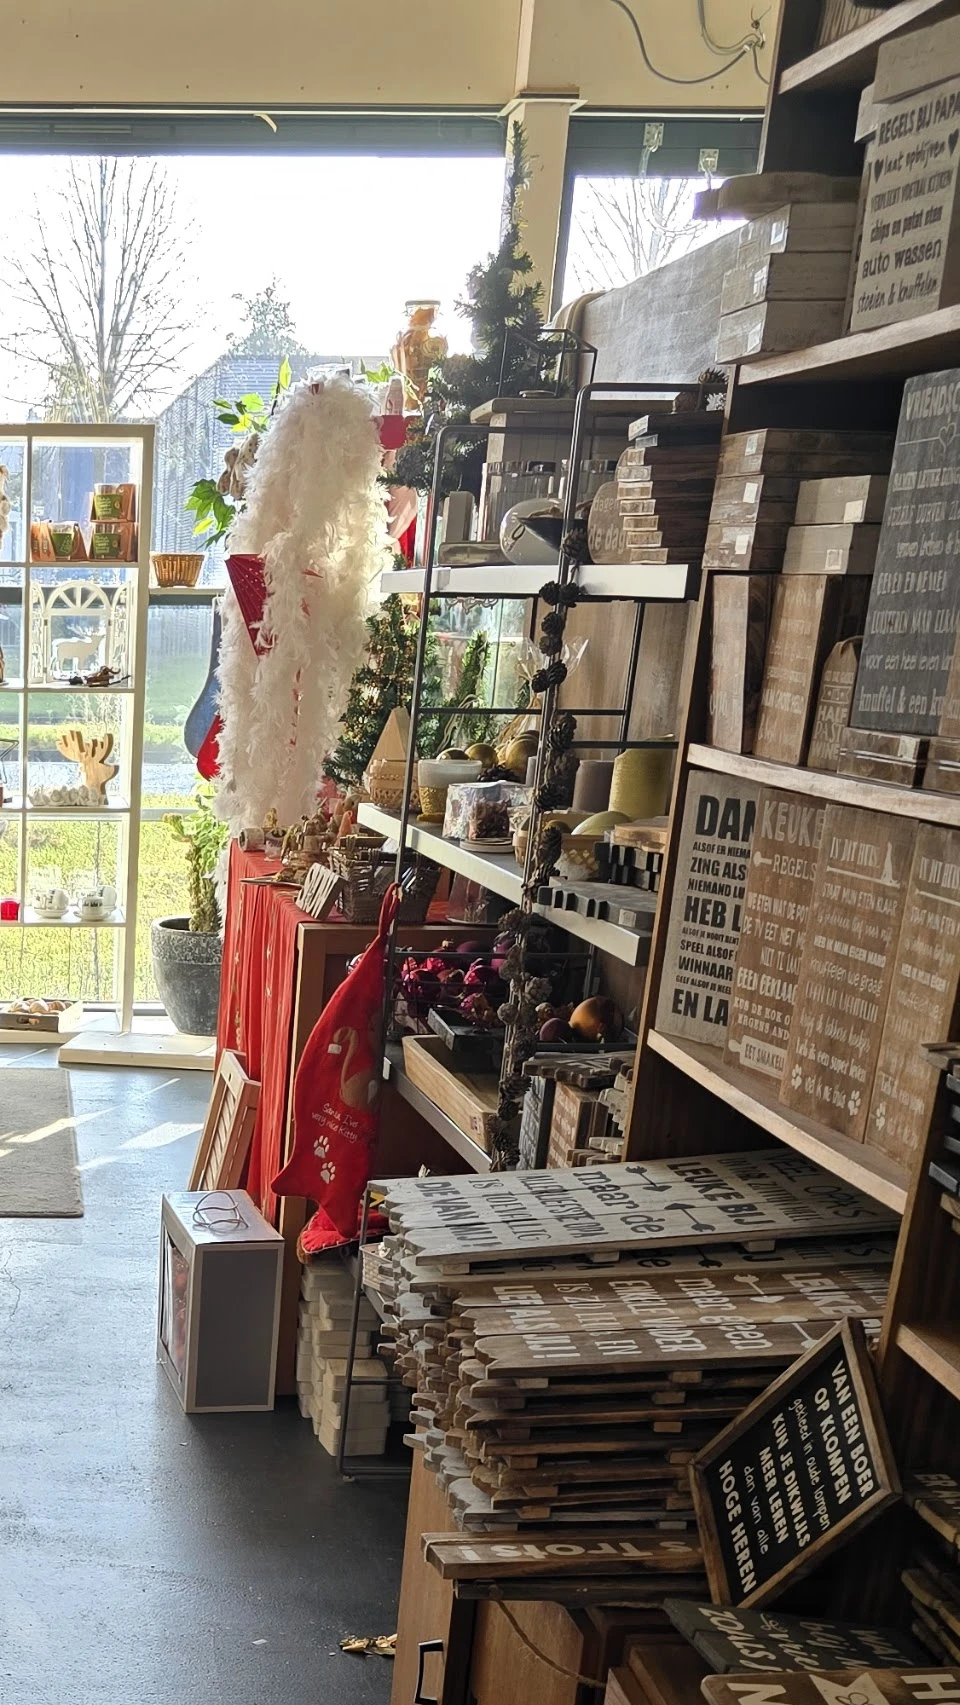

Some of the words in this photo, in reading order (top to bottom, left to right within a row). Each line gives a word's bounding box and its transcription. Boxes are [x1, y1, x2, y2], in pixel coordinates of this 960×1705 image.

[878, 109, 916, 147] REGELS
[916, 101, 933, 131] BIJ
[884, 151, 904, 176] laat
[862, 252, 890, 279] auto
[894, 239, 942, 269] wassen
[817, 705, 848, 723] HALF
[858, 685, 897, 714] knuffel
[908, 694, 928, 715] een
[693, 842, 715, 855] ALSOF
[716, 844, 726, 856] ER
[690, 856, 720, 877] ZING
[772, 854, 817, 881] REGELS
[687, 878, 731, 897] NIEMAND
[683, 896, 727, 929] HEB
[764, 922, 779, 941] EET
[680, 939, 704, 955] SPEEL
[706, 945, 734, 960] ALSOF
[678, 955, 733, 981] WINNAAR
[672, 988, 699, 1018] EN
[703, 995, 729, 1027] LA
[468, 1178, 505, 1189] IS
[767, 1153, 824, 1181] VEEL
[415, 1181, 461, 1198] DIE
[517, 1174, 595, 1223] ALLERLIEFSTE
[562, 1222, 610, 1238] OPA
[572, 1171, 640, 1210] maar
[619, 1214, 665, 1234] de
[665, 1162, 745, 1202] LEUKE
[716, 1203, 775, 1226] BIJ
[432, 1197, 480, 1221] VAN
[482, 1191, 552, 1242] TOEVALLIG
[492, 1284, 546, 1306] LIEF
[553, 1281, 593, 1293] IS
[562, 1294, 607, 1310] ZO
[608, 1280, 674, 1316] ENKELE
[674, 1277, 737, 1311] maar
[781, 1272, 867, 1315] LEUKE
[505, 1308, 562, 1332] ALS
[639, 1316, 707, 1353] VADER
[699, 1314, 774, 1350] geen
[522, 1333, 582, 1360] JIJ!
[594, 1338, 643, 1357] EN
[831, 1360, 852, 1404] VAN
[814, 1387, 829, 1412] OP
[771, 1412, 788, 1450] KUN
[788, 1397, 813, 1440] gekleed
[841, 1403, 861, 1444] EEN
[780, 1450, 792, 1471] JE
[802, 1441, 815, 1454] in
[819, 1414, 852, 1504] KLOMPEN
[758, 1446, 777, 1492] MEER
[805, 1457, 820, 1486] oude
[850, 1443, 875, 1497] BOER
[718, 1459, 743, 1521] HOGE
[743, 1464, 757, 1492] dan
[750, 1495, 762, 1524] van
[756, 1529, 769, 1555] alle
[767, 1491, 790, 1544] LEREN
[783, 1469, 811, 1548] DIKWIJLS
[811, 1484, 831, 1531] lompen
[457, 1541, 654, 1562] Trots!
[730, 1522, 757, 1593] HEREN
[695, 1607, 779, 1660] ZOALS
